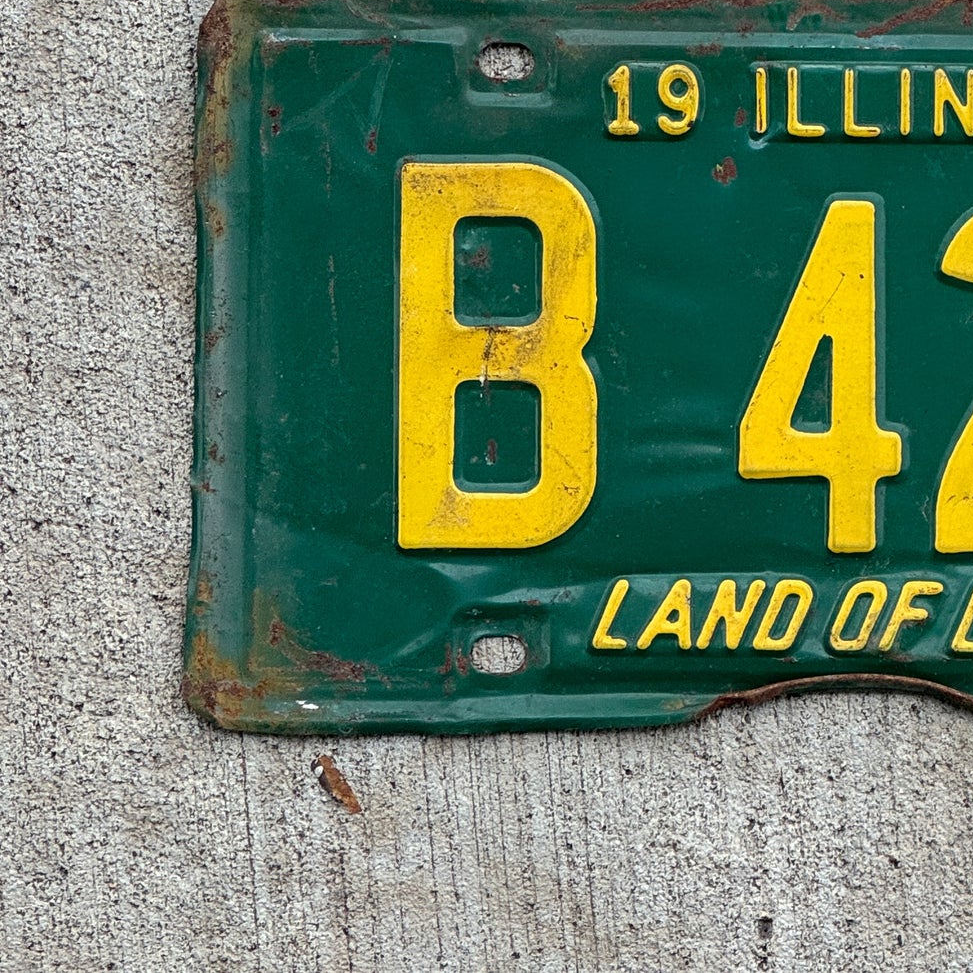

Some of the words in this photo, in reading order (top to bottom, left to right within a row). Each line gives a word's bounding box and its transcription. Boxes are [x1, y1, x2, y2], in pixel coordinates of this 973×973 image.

[606, 63, 701, 136] 19
[396, 161, 599, 550] B
[591, 578, 815, 651] LAND
[830, 580, 944, 652] OF
